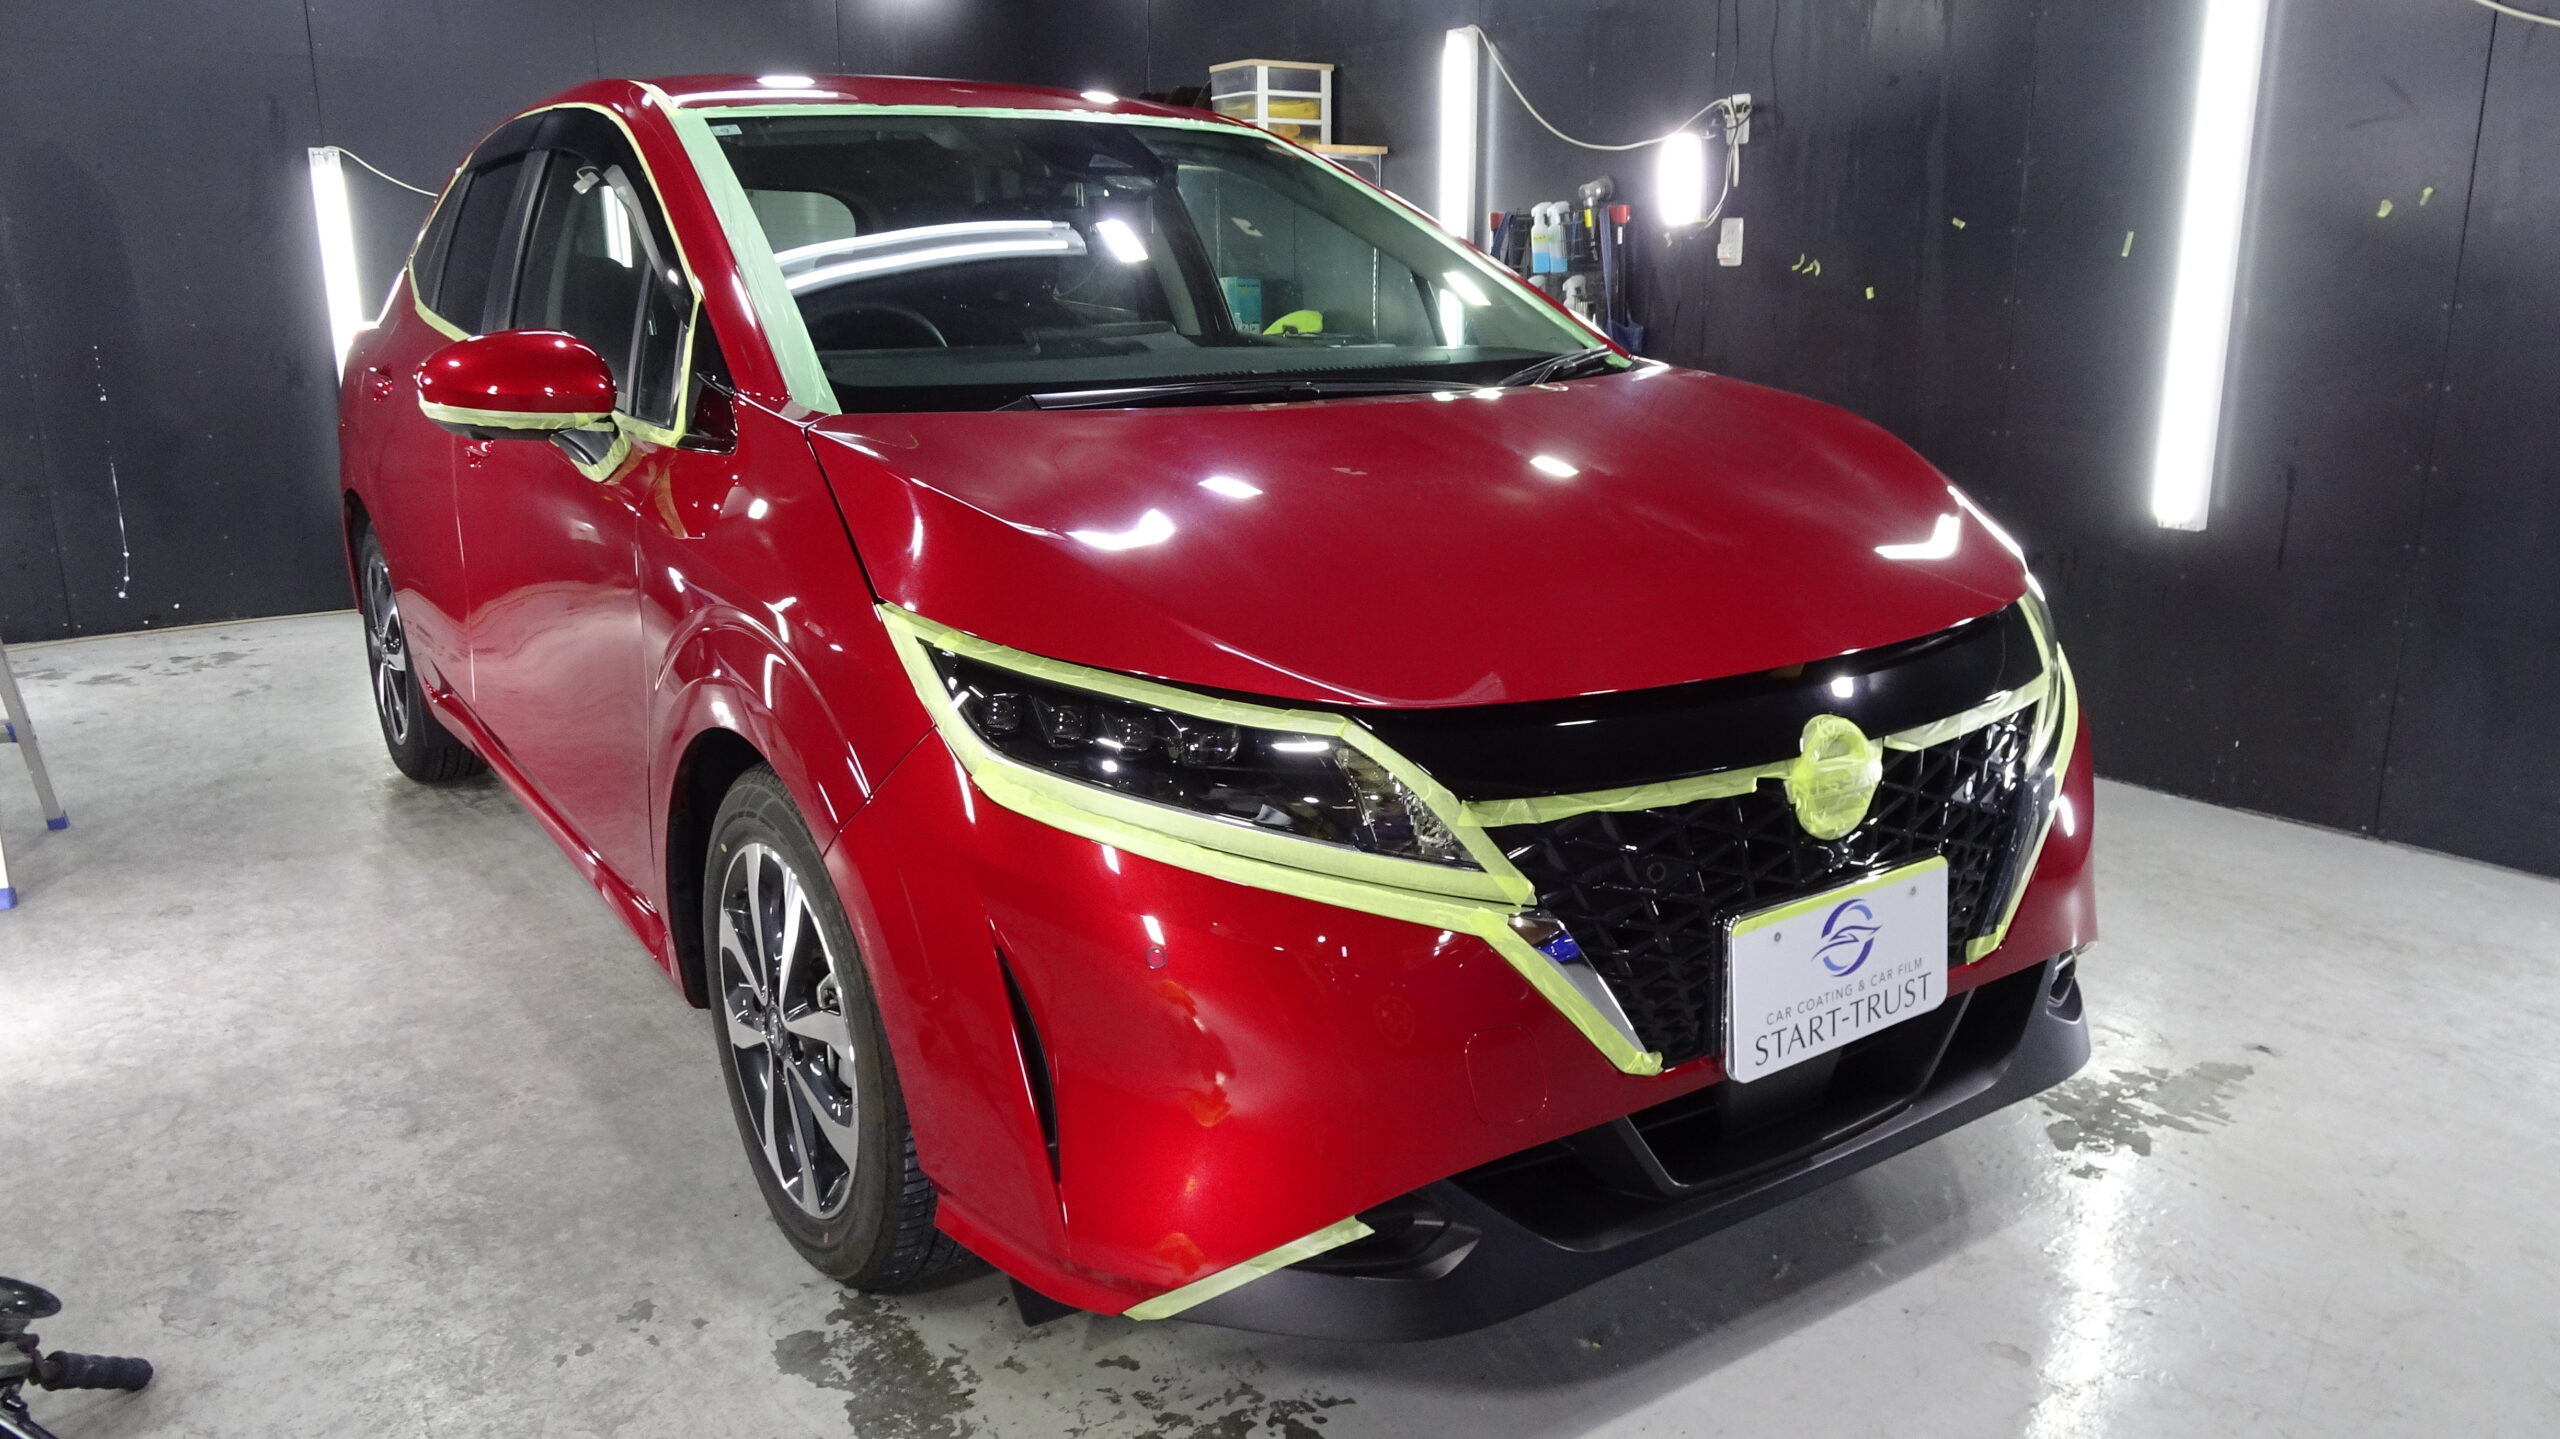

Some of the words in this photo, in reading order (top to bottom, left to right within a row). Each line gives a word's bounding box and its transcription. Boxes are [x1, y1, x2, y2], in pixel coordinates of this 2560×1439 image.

[1755, 972, 1932, 1067] START-TRUST
[1766, 1006, 1792, 1026] CAR
[1797, 985, 1853, 1015] COATING
[1858, 979, 1865, 992] &
[1870, 968, 1893, 987] CAR
[1897, 957, 1923, 974] FILM
